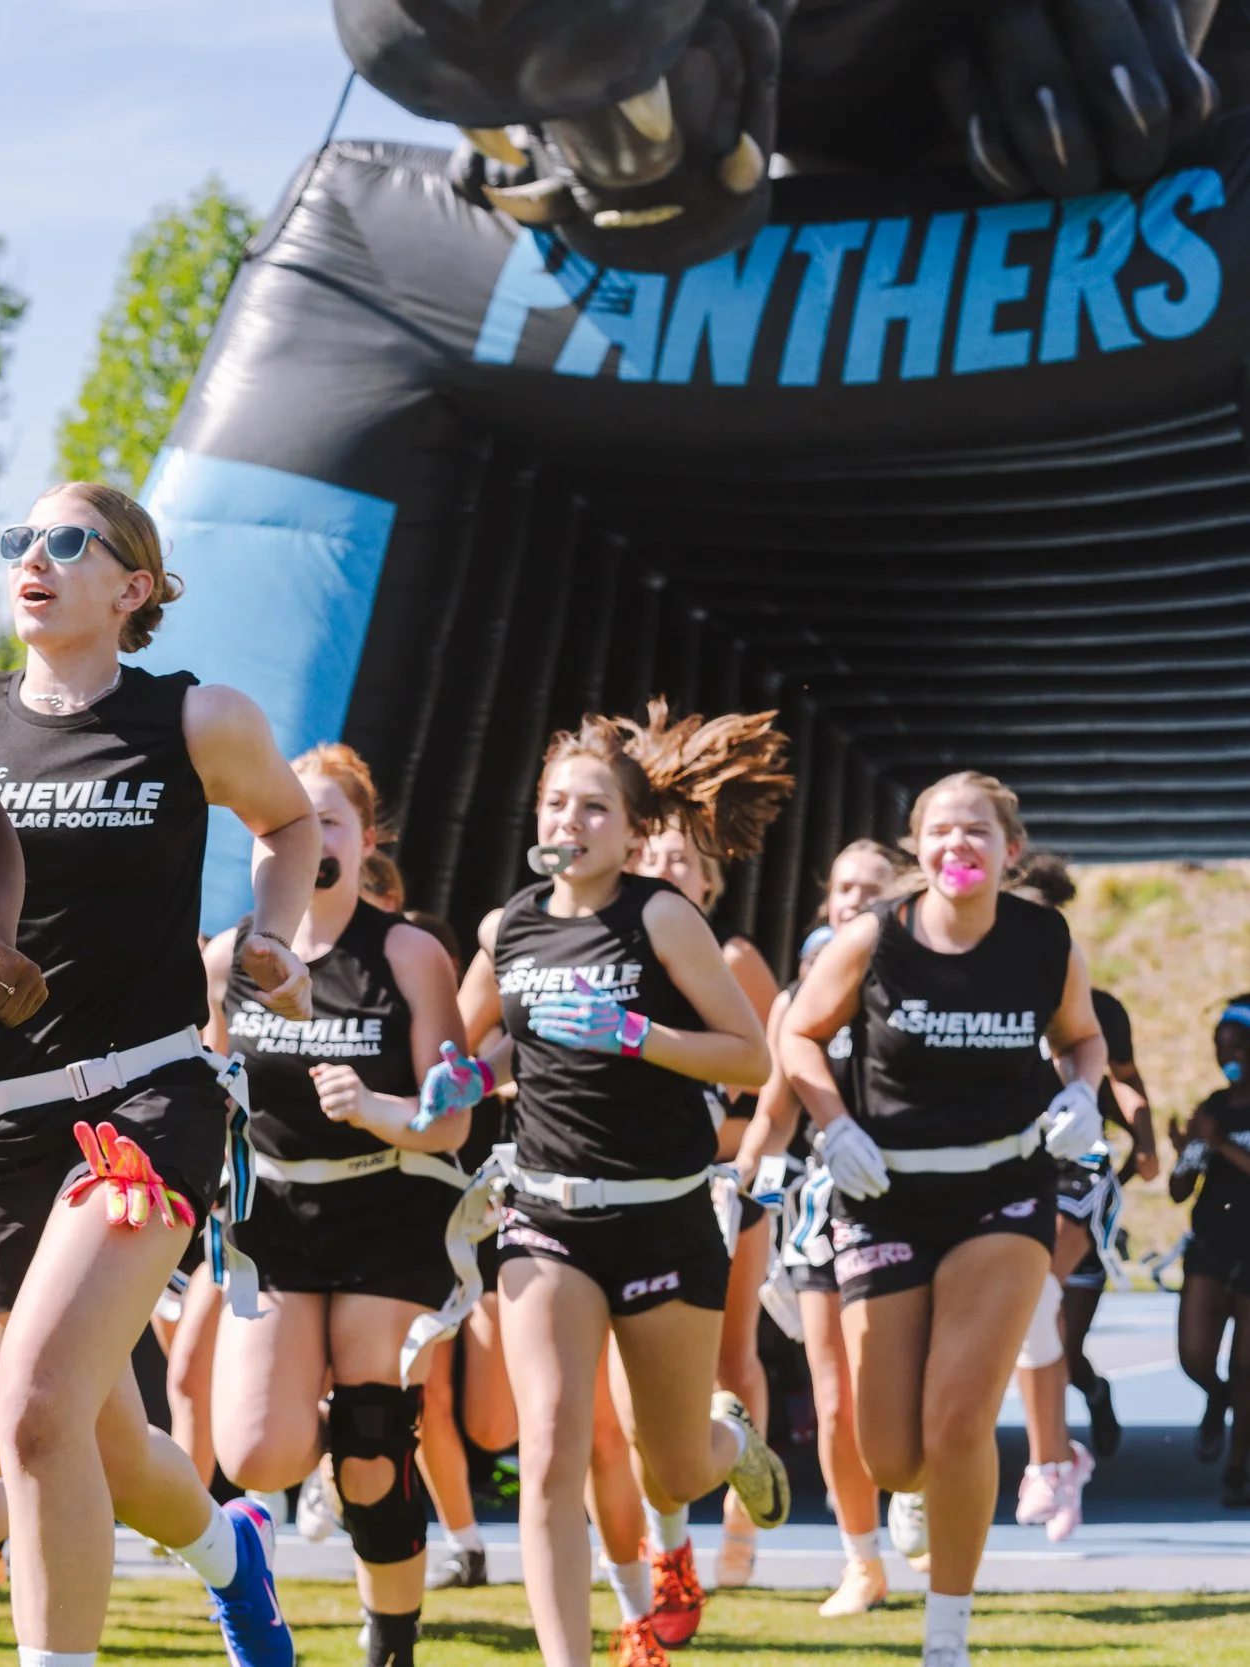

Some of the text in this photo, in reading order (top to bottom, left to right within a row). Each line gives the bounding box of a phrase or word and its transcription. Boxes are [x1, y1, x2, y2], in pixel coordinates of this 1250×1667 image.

[472, 168, 1226, 386] PANTHERS
[6, 811, 154, 828] LAG FOOTBALL
[227, 1011, 383, 1043] ASHEVILLE
[887, 1009, 1035, 1034] ASHEVILLE
[256, 1038, 382, 1057] FLAG FOOTBALL
